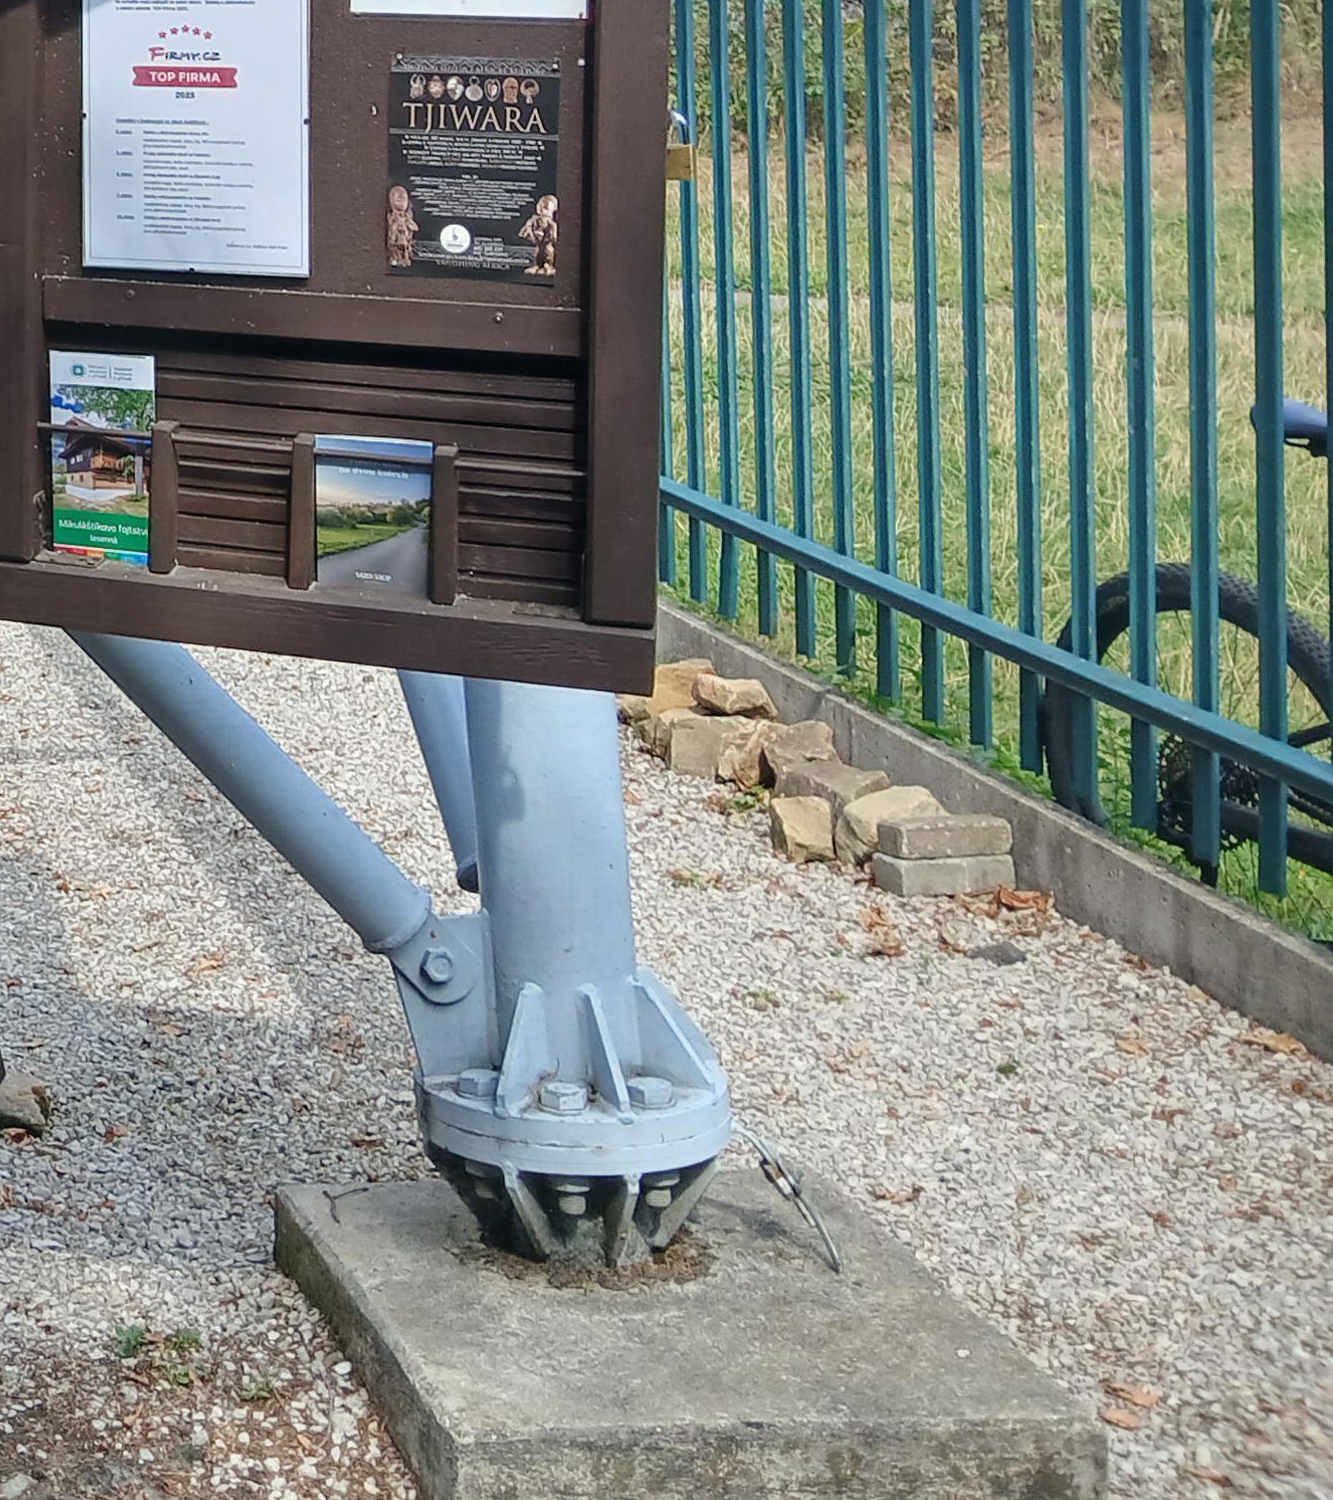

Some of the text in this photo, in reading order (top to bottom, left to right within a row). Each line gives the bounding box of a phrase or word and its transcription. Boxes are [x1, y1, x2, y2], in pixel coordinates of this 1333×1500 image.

[149, 71, 221, 83] TOP FIRMA
[402, 102, 547, 134] TJIWARA
